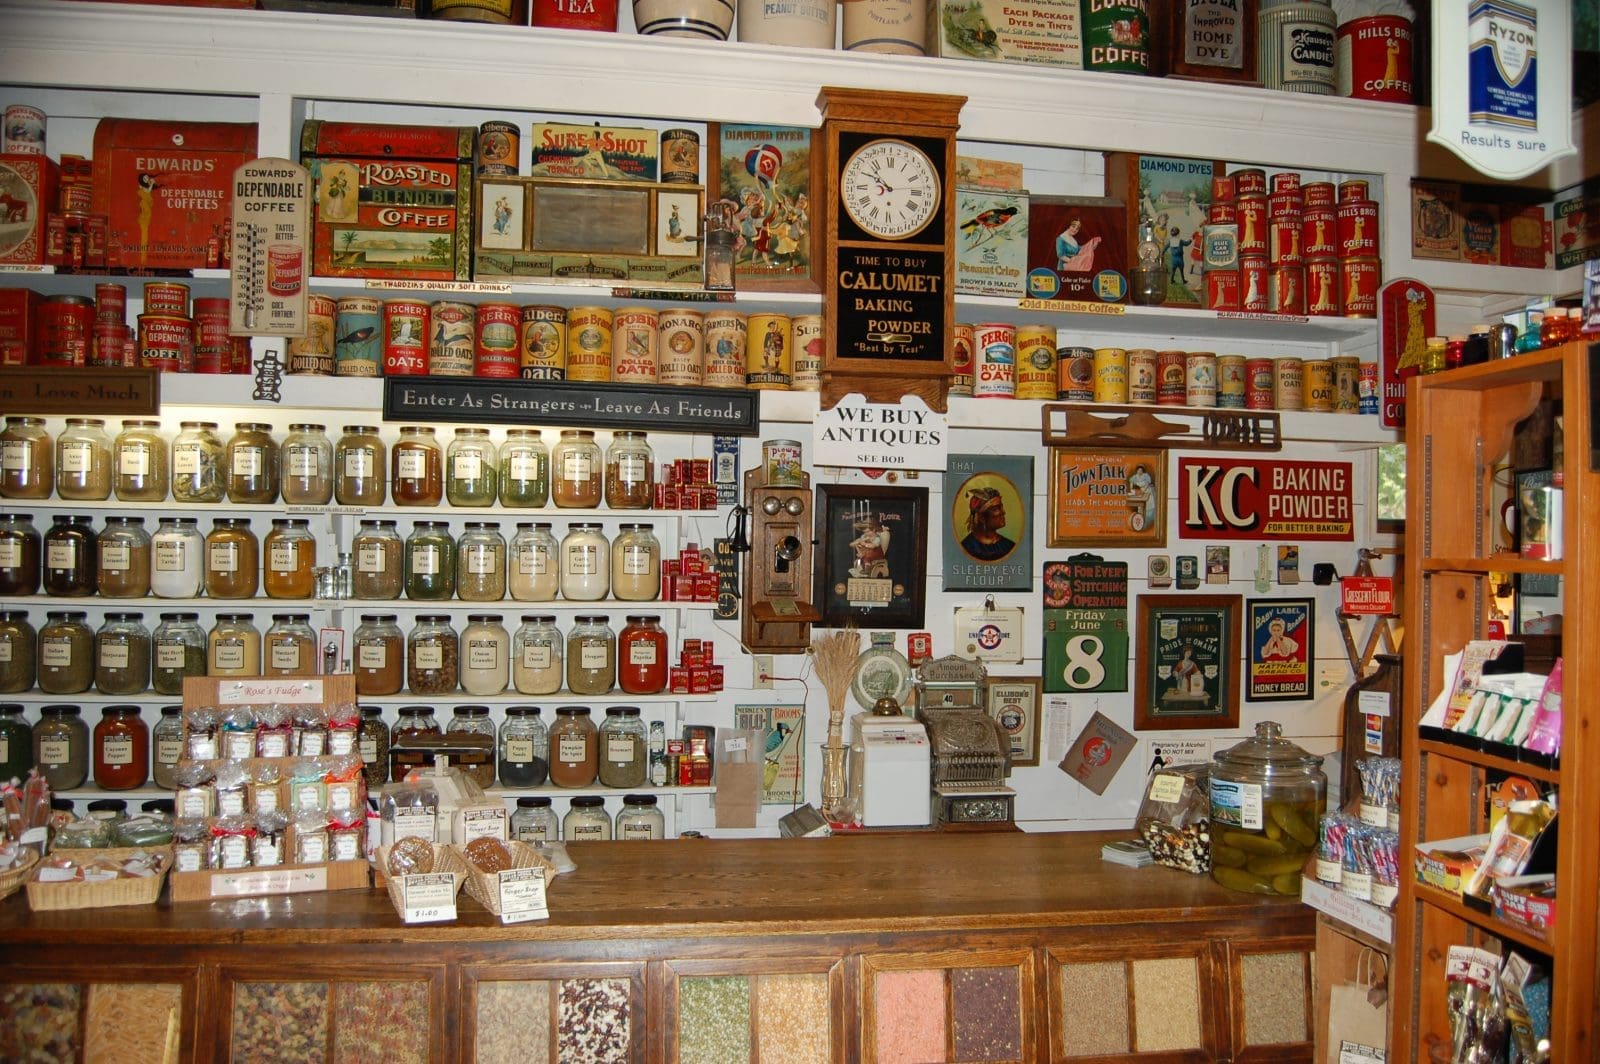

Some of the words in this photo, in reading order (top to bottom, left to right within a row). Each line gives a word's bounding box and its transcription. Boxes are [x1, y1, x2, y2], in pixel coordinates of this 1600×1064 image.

[765, 4, 796, 15] PEANUT
[1003, 7, 1028, 17] EACH
[1032, 9, 1075, 21] PACKAGE
[1008, 18, 1034, 27] DYES
[1047, 21, 1073, 31] TINTS
[1194, 15, 1235, 28] IMPROVED
[1192, 30, 1233, 45] HOME
[1358, 26, 1391, 39] HILLS
[1489, 21, 1534, 46] RYZON
[1196, 46, 1230, 59] DYE
[1292, 46, 1334, 64] CANDIES
[541, 128, 587, 149] SURE
[603, 131, 648, 154] SHOT
[725, 130, 773, 141] DIAMOND
[1461, 131, 1511, 148] Results
[1517, 140, 1546, 152] sure
[136, 157, 218, 172] EDWARDS'
[546, 165, 585, 176] TOBACCO
[1140, 159, 1185, 173] DIAMOND
[1188, 163, 1212, 175] DYES
[245, 169, 297, 178] EDWARDS'
[360, 162, 451, 186] ROASTED
[161, 188, 225, 199] DEPENDABLE
[237, 182, 304, 199] DEPENDABLE
[371, 189, 449, 205] BLENDED
[167, 199, 218, 210] COFFEES
[244, 202, 295, 213] COFFEE
[377, 208, 449, 227] COFFEE
[1303, 214, 1319, 222] HILLS
[1338, 208, 1359, 217] HILLS
[275, 223, 295, 232] TASTES
[1306, 245, 1334, 253] COFFEE
[1343, 239, 1374, 248] COFFEE
[854, 255, 881, 266] TIME
[885, 257, 901, 267] TO
[904, 257, 927, 268] BUY
[958, 262, 994, 275] Peanut
[995, 265, 1021, 278] Crisp
[427, 283, 456, 291] QUALITY
[839, 271, 941, 293] CALUMET
[960, 278, 986, 286] BROWN
[994, 280, 1018, 288] HALEY
[855, 298, 913, 313] BAKING
[1022, 299, 1042, 309] Old
[1044, 301, 1086, 312] Reliable
[1088, 304, 1120, 314] Coffee
[1348, 303, 1374, 311] COFFEE
[523, 309, 566, 321] Albers
[660, 318, 703, 333] MONARC
[796, 325, 821, 337] SUP
[868, 319, 932, 334] POWDER
[455, 348, 473, 360] OATS
[883, 344, 894, 355] by
[388, 356, 424, 369] OATS
[523, 367, 561, 381] oats
[616, 365, 656, 376] OATS
[707, 365, 733, 374] ROLLED
[35, 383, 79, 400] Love
[88, 384, 139, 400] Much
[403, 389, 454, 405] Enter
[462, 394, 483, 407] As
[490, 394, 575, 413] Strangers
[595, 398, 642, 414] Leave
[648, 401, 670, 415] As
[678, 401, 742, 420] Friends
[837, 407, 873, 423] WE
[881, 409, 929, 425] BUY
[821, 427, 941, 447] ANTIQUES
[857, 454, 879, 464] SEE
[882, 455, 905, 464] BOB
[951, 461, 975, 471] THAT
[1063, 465, 1096, 494] TOWN
[1096, 463, 1127, 482] TALK
[1088, 484, 1127, 497] FLOUR
[1185, 464, 1256, 527] KC
[1273, 467, 1345, 491] BAKING
[1268, 494, 1348, 519] POWDER
[1268, 523, 1283, 531] FOR
[1285, 523, 1314, 532] BETTER
[1316, 524, 1344, 533] BAKING
[952, 565, 997, 575] SLEEPY
[1003, 565, 1024, 576] EYE
[1074, 565, 1094, 577] FOR
[1094, 566, 1126, 579] EVERY
[1073, 580, 1126, 593] STITCHING
[1073, 594, 1126, 607] OPERATION
[1065, 610, 1106, 622] Friday
[1276, 607, 1301, 615] LABEL
[1070, 620, 1101, 630] June
[1255, 609, 1274, 630] BABY
[1287, 612, 1306, 632] BRAND
[1160, 637, 1183, 654] PRIDE
[1193, 638, 1217, 653] OMAHA
[1063, 634, 1106, 690] 8
[930, 671, 975, 680] Purchased
[244, 686, 273, 696] Rose's
[275, 686, 302, 696] Fudge
[1254, 683, 1279, 693] HONEY
[1280, 683, 1305, 692] BREAD
